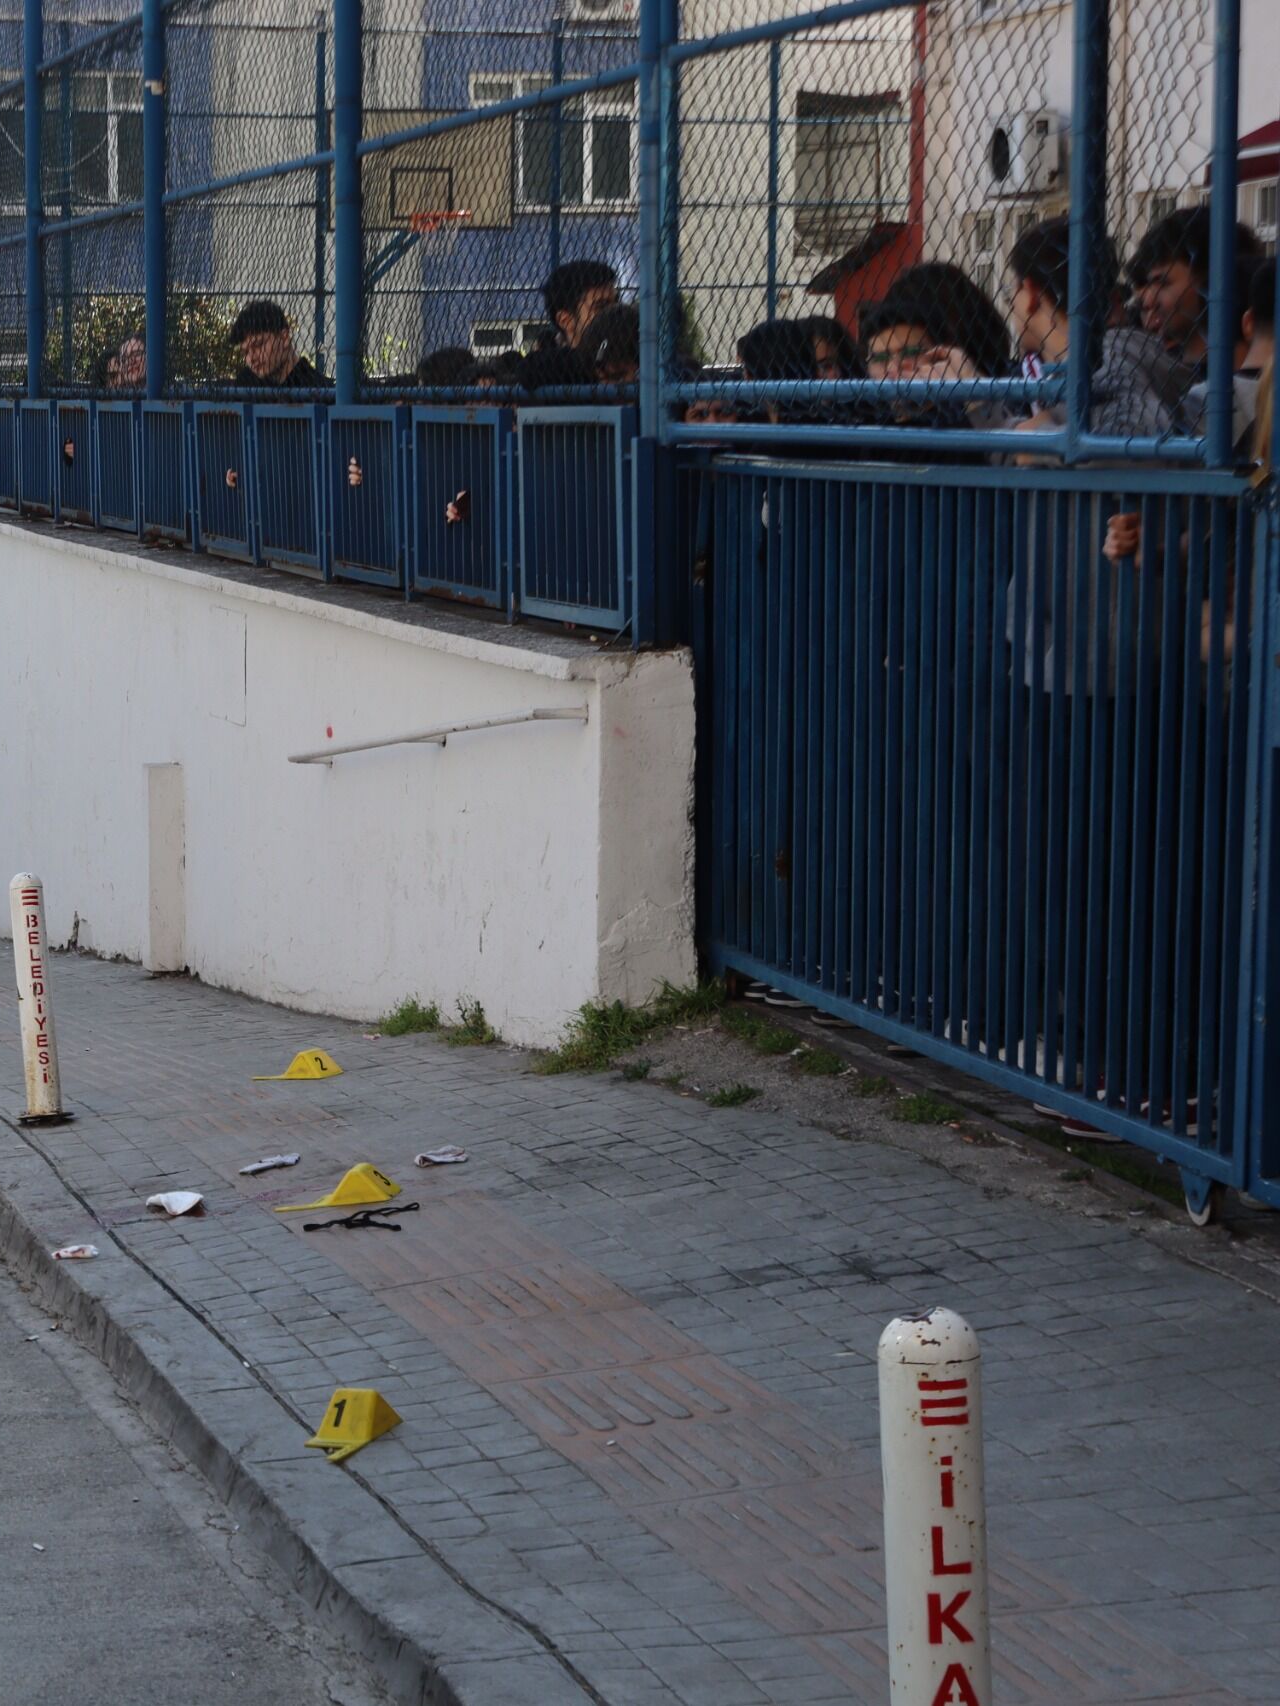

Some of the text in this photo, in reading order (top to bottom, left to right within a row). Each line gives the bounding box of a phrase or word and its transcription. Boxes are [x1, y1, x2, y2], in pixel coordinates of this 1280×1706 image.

[26, 914, 50, 1084] BELEDİYESİ
[314, 1056, 328, 1072] 2
[372, 1169, 392, 1187] 3
[332, 1398, 348, 1428] 1
